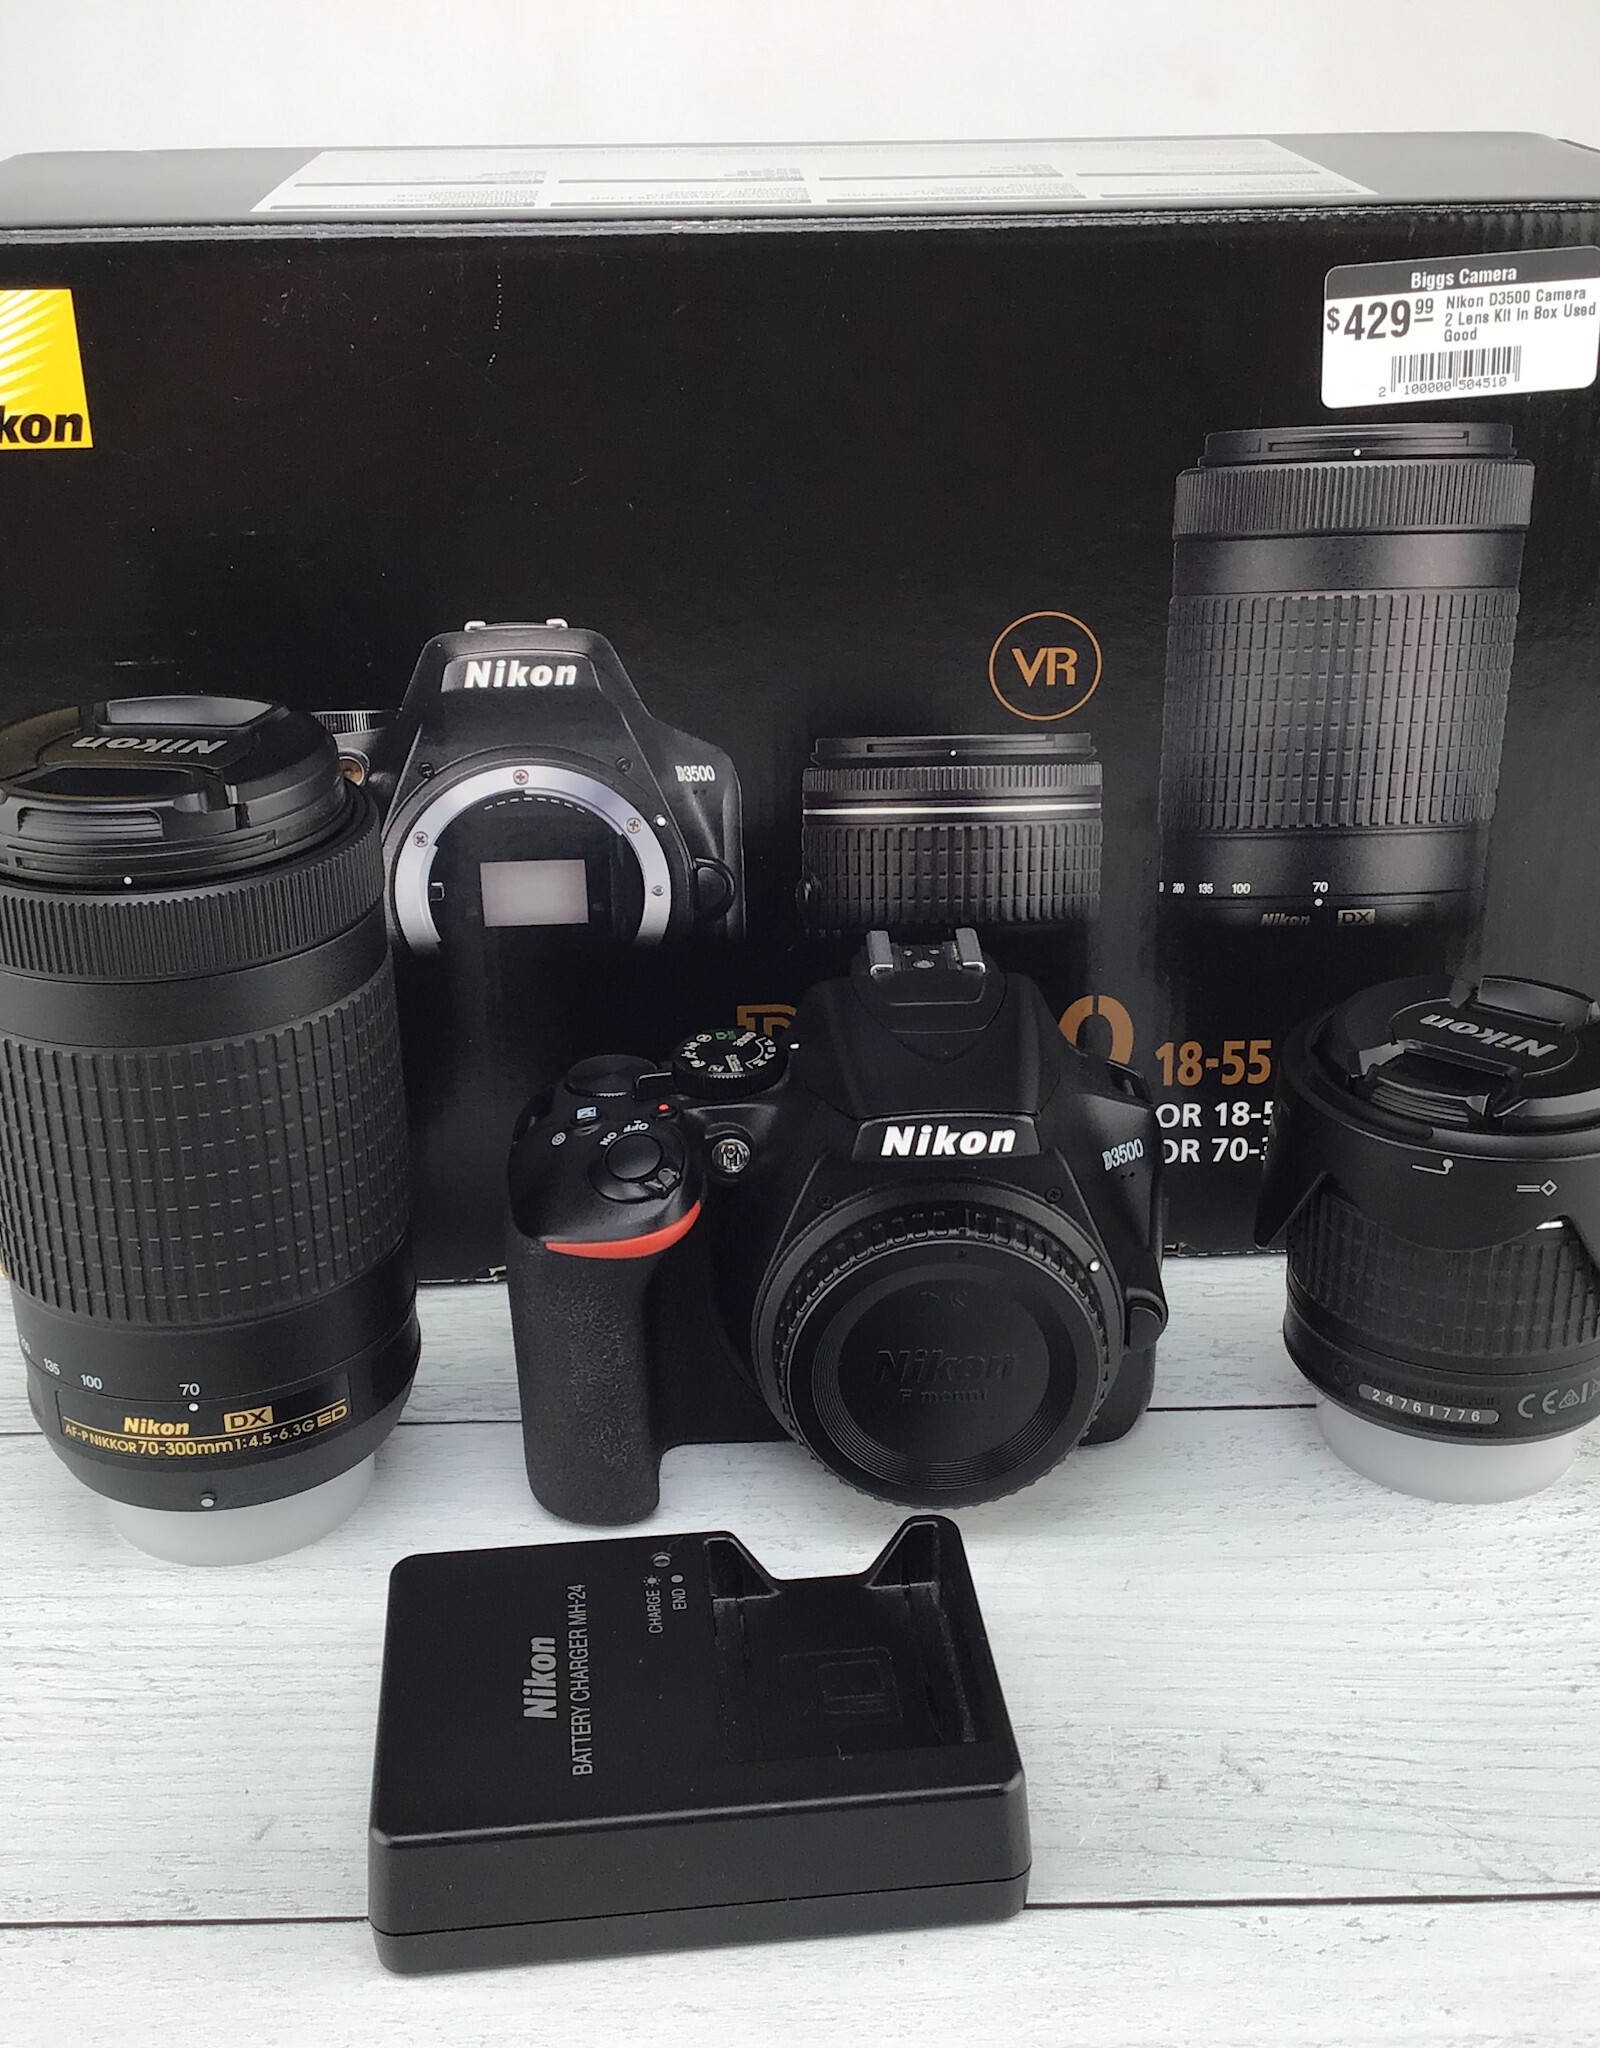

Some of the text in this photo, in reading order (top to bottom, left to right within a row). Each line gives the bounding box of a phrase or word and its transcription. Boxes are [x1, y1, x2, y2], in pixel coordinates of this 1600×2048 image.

[1410, 267, 1518, 290] Biggs Camera
[1489, 290, 1531, 306] D3500
[1536, 288, 1586, 303] Camera
[1444, 312, 1453, 327] 2
[1458, 311, 1490, 326] Lens
[1533, 305, 1558, 320] Box
[1563, 301, 1597, 318] Used
[1444, 326, 1478, 343] Good
[1378, 376, 1508, 398] 2 100000 504510
[463, 659, 578, 689] Nikon
[1011, 646, 1079, 688] VR
[71, 735, 228, 755] Nikon
[674, 764, 716, 783] D3500
[1198, 882, 1215, 895] 135
[1231, 882, 1251, 895] 100
[1312, 881, 1329, 894] 70
[1261, 911, 1371, 927] Nikon DX
[1419, 1013, 1558, 1058] Nikon
[1155, 1039, 1272, 1087] 18-55
[880, 1124, 1017, 1157] Nikon
[1101, 1138, 1144, 1172] D3500
[43, 1357, 61, 1376] 135
[80, 1373, 103, 1390] 100
[179, 1382, 201, 1397] 70
[1370, 1388, 1482, 1423] 24761776
[64, 1423, 89, 1442] AF-P
[89, 1434, 138, 1454] NIKKOR
[317, 1404, 348, 1428] ED
[123, 1408, 269, 1436] Nikon DX
[645, 1588, 664, 1635] CHARGE
[671, 1587, 688, 1611] END
[521, 1635, 558, 1720] Nikon
[566, 1583, 594, 1776] BATTERY CHARGER MH-24
